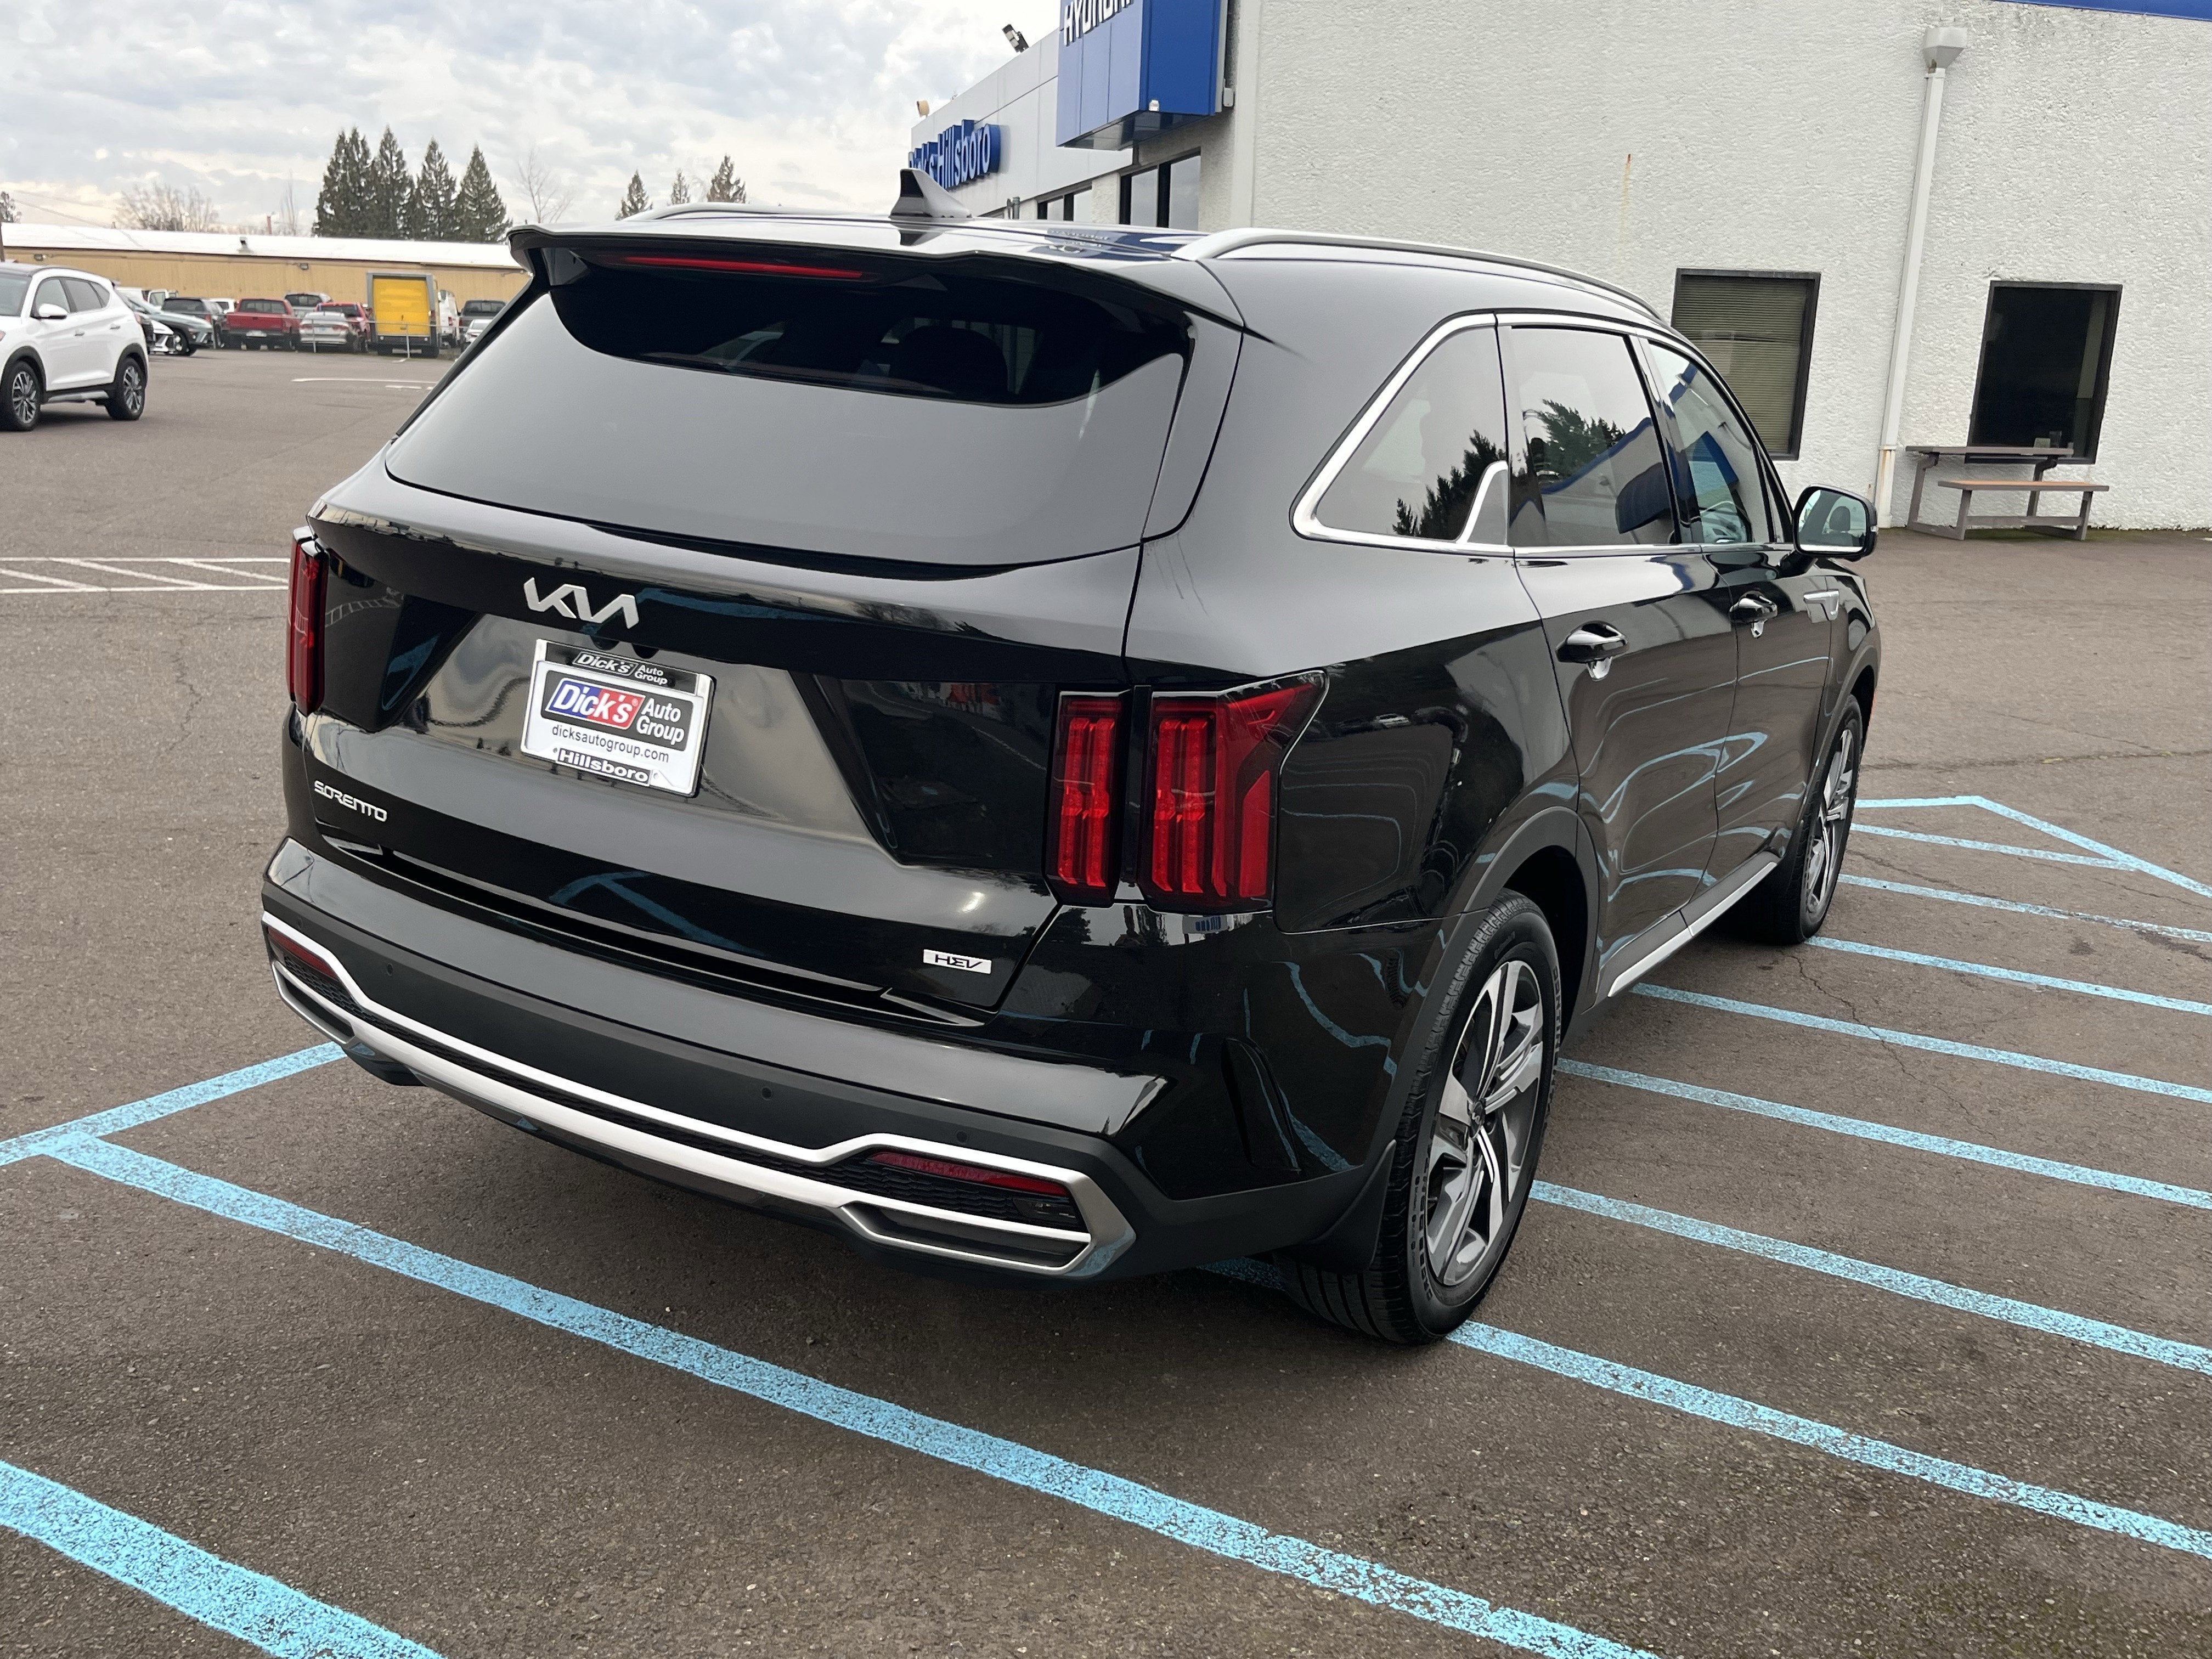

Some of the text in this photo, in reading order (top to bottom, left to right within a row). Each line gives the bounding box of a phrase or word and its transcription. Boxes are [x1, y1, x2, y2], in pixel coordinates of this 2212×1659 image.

[938, 119, 991, 189] Hillsboro
[524, 577, 639, 629] KIA
[578, 654, 630, 673] Dick's
[635, 672, 668, 685] Group
[637, 665, 663, 676] Auto
[553, 684, 633, 723] Dick's
[641, 698, 681, 723] Auto
[552, 724, 669, 763] dicksautogroup.com
[636, 715, 685, 745] Group
[558, 748, 648, 782] Hillsboro
[314, 780, 387, 822] SORENTO
[935, 954, 983, 969] HEV
